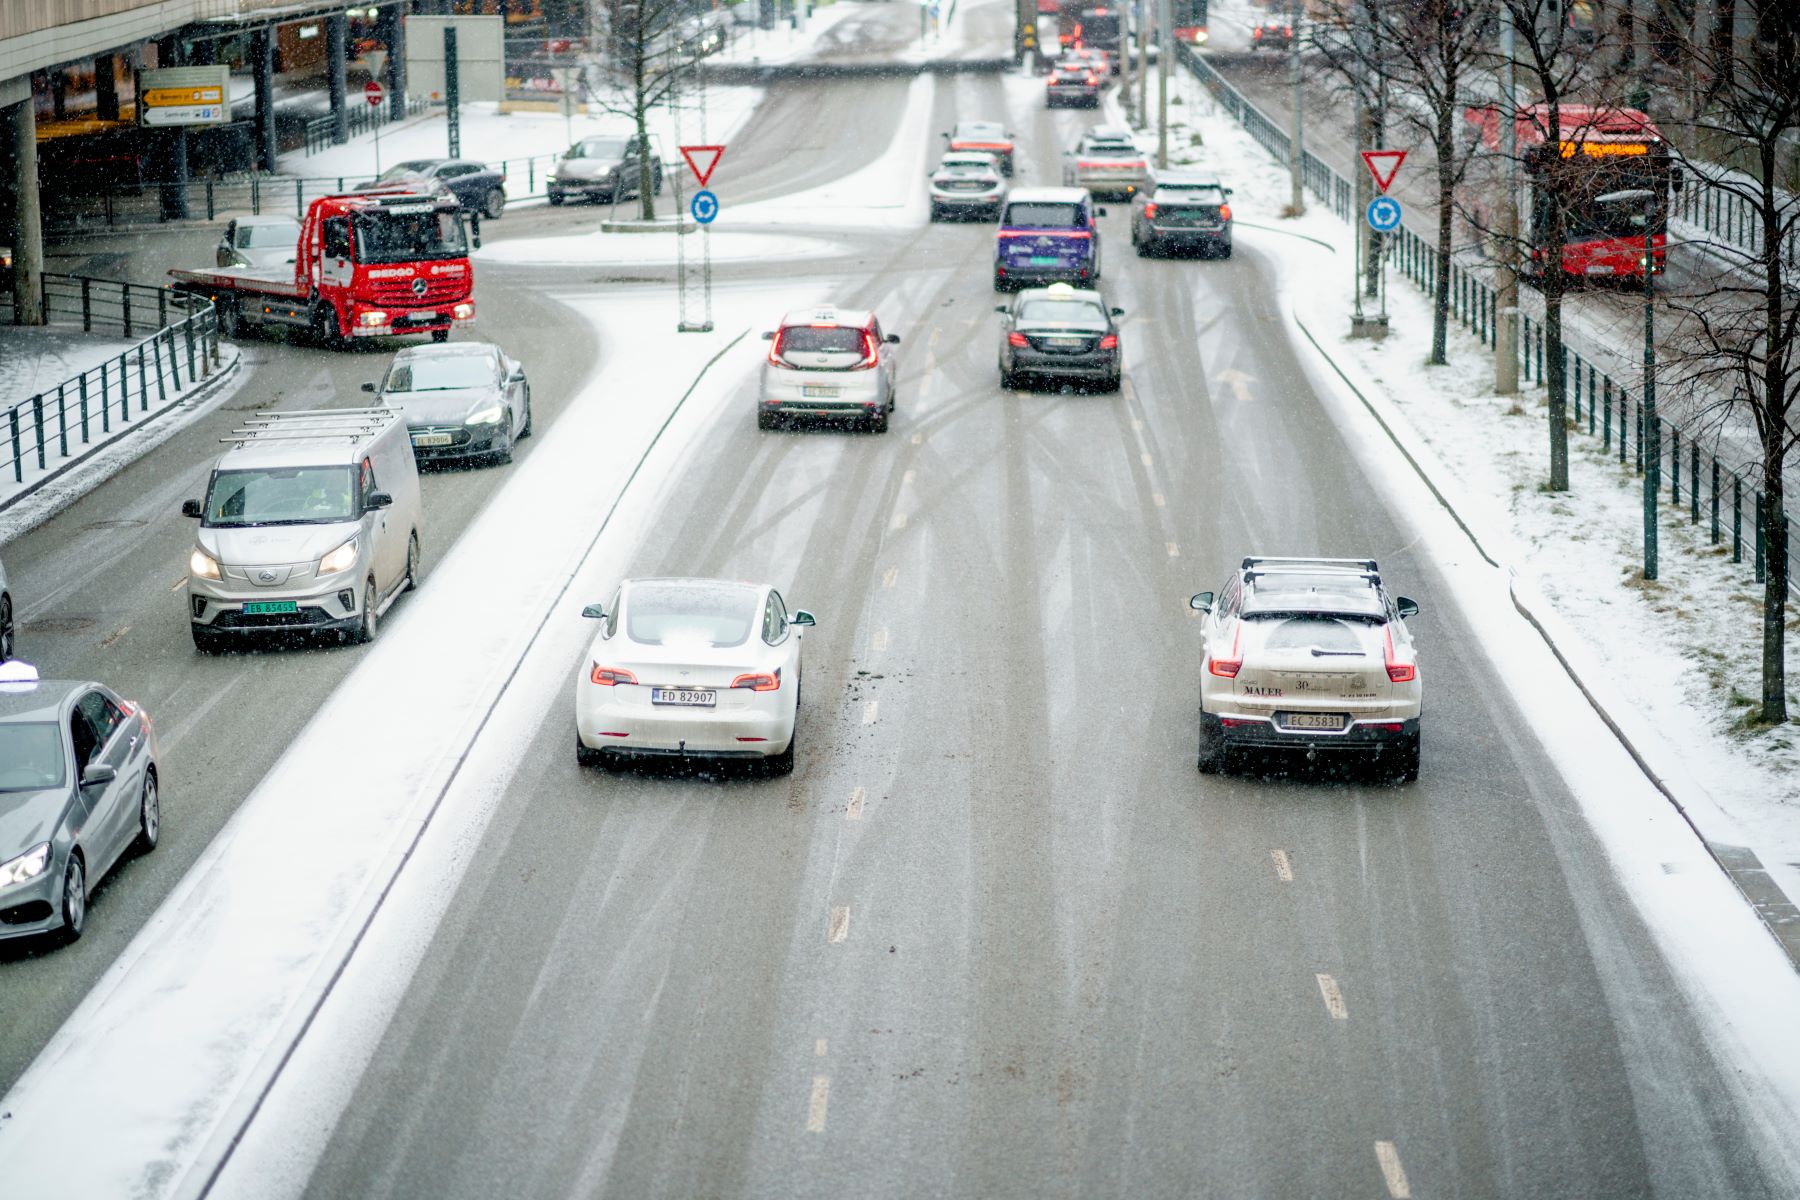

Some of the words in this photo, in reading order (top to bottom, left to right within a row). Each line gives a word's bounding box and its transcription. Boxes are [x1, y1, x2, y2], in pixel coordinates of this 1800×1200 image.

[250, 604, 262, 613] EB
[1244, 685, 1282, 697] MALER
[1295, 680, 1309, 691] 30
[662, 691, 675, 701] ED
[680, 691, 713, 702] 82907
[1291, 715, 1304, 726] EC
[1308, 715, 1340, 727] 25831
